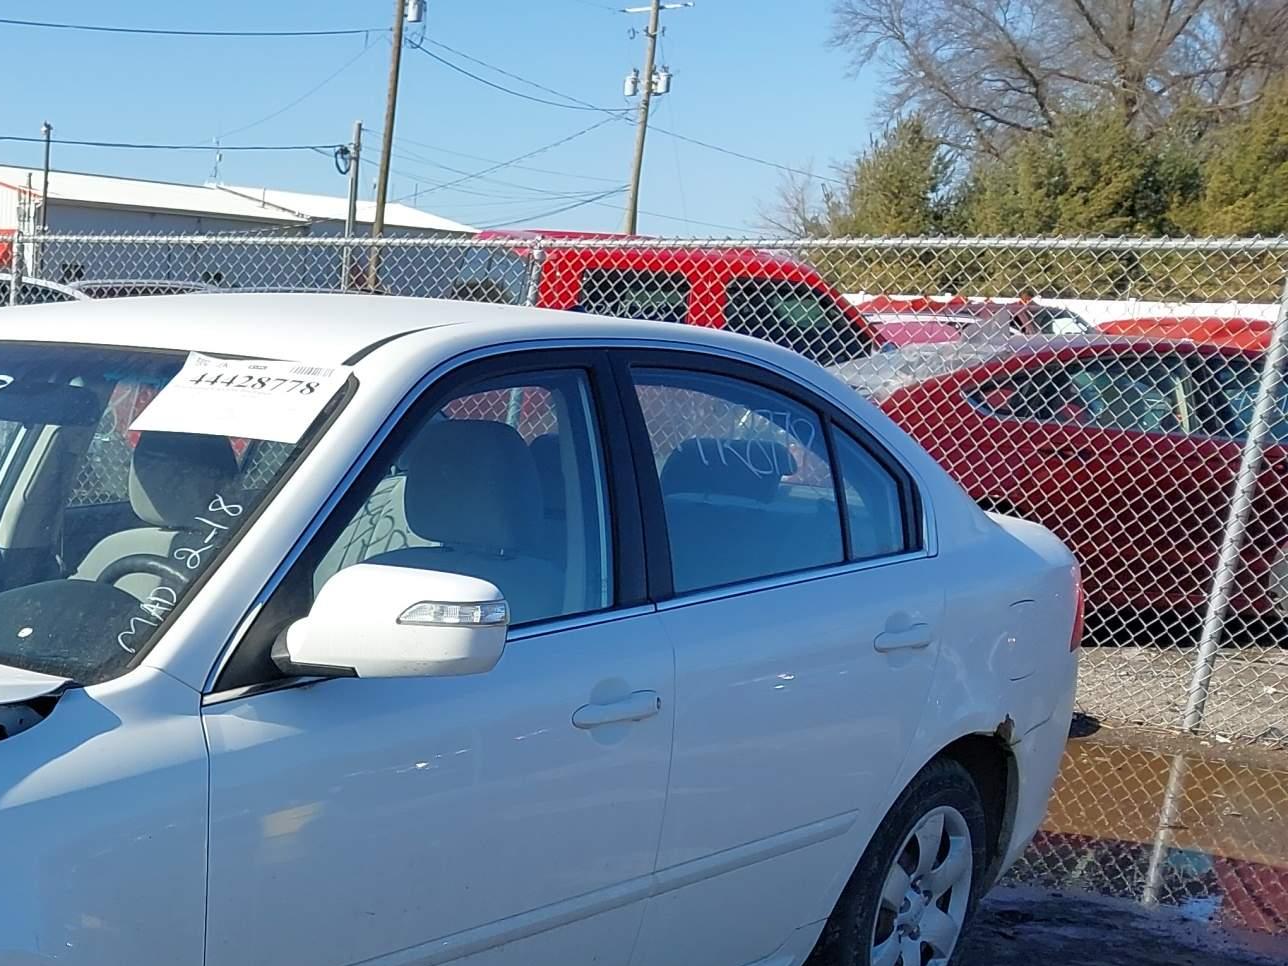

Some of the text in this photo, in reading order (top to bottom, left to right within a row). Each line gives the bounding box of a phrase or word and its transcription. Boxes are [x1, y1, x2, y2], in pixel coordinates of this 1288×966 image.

[188, 372, 321, 395] 44428778
[117, 493, 244, 654] MAD 2-18
